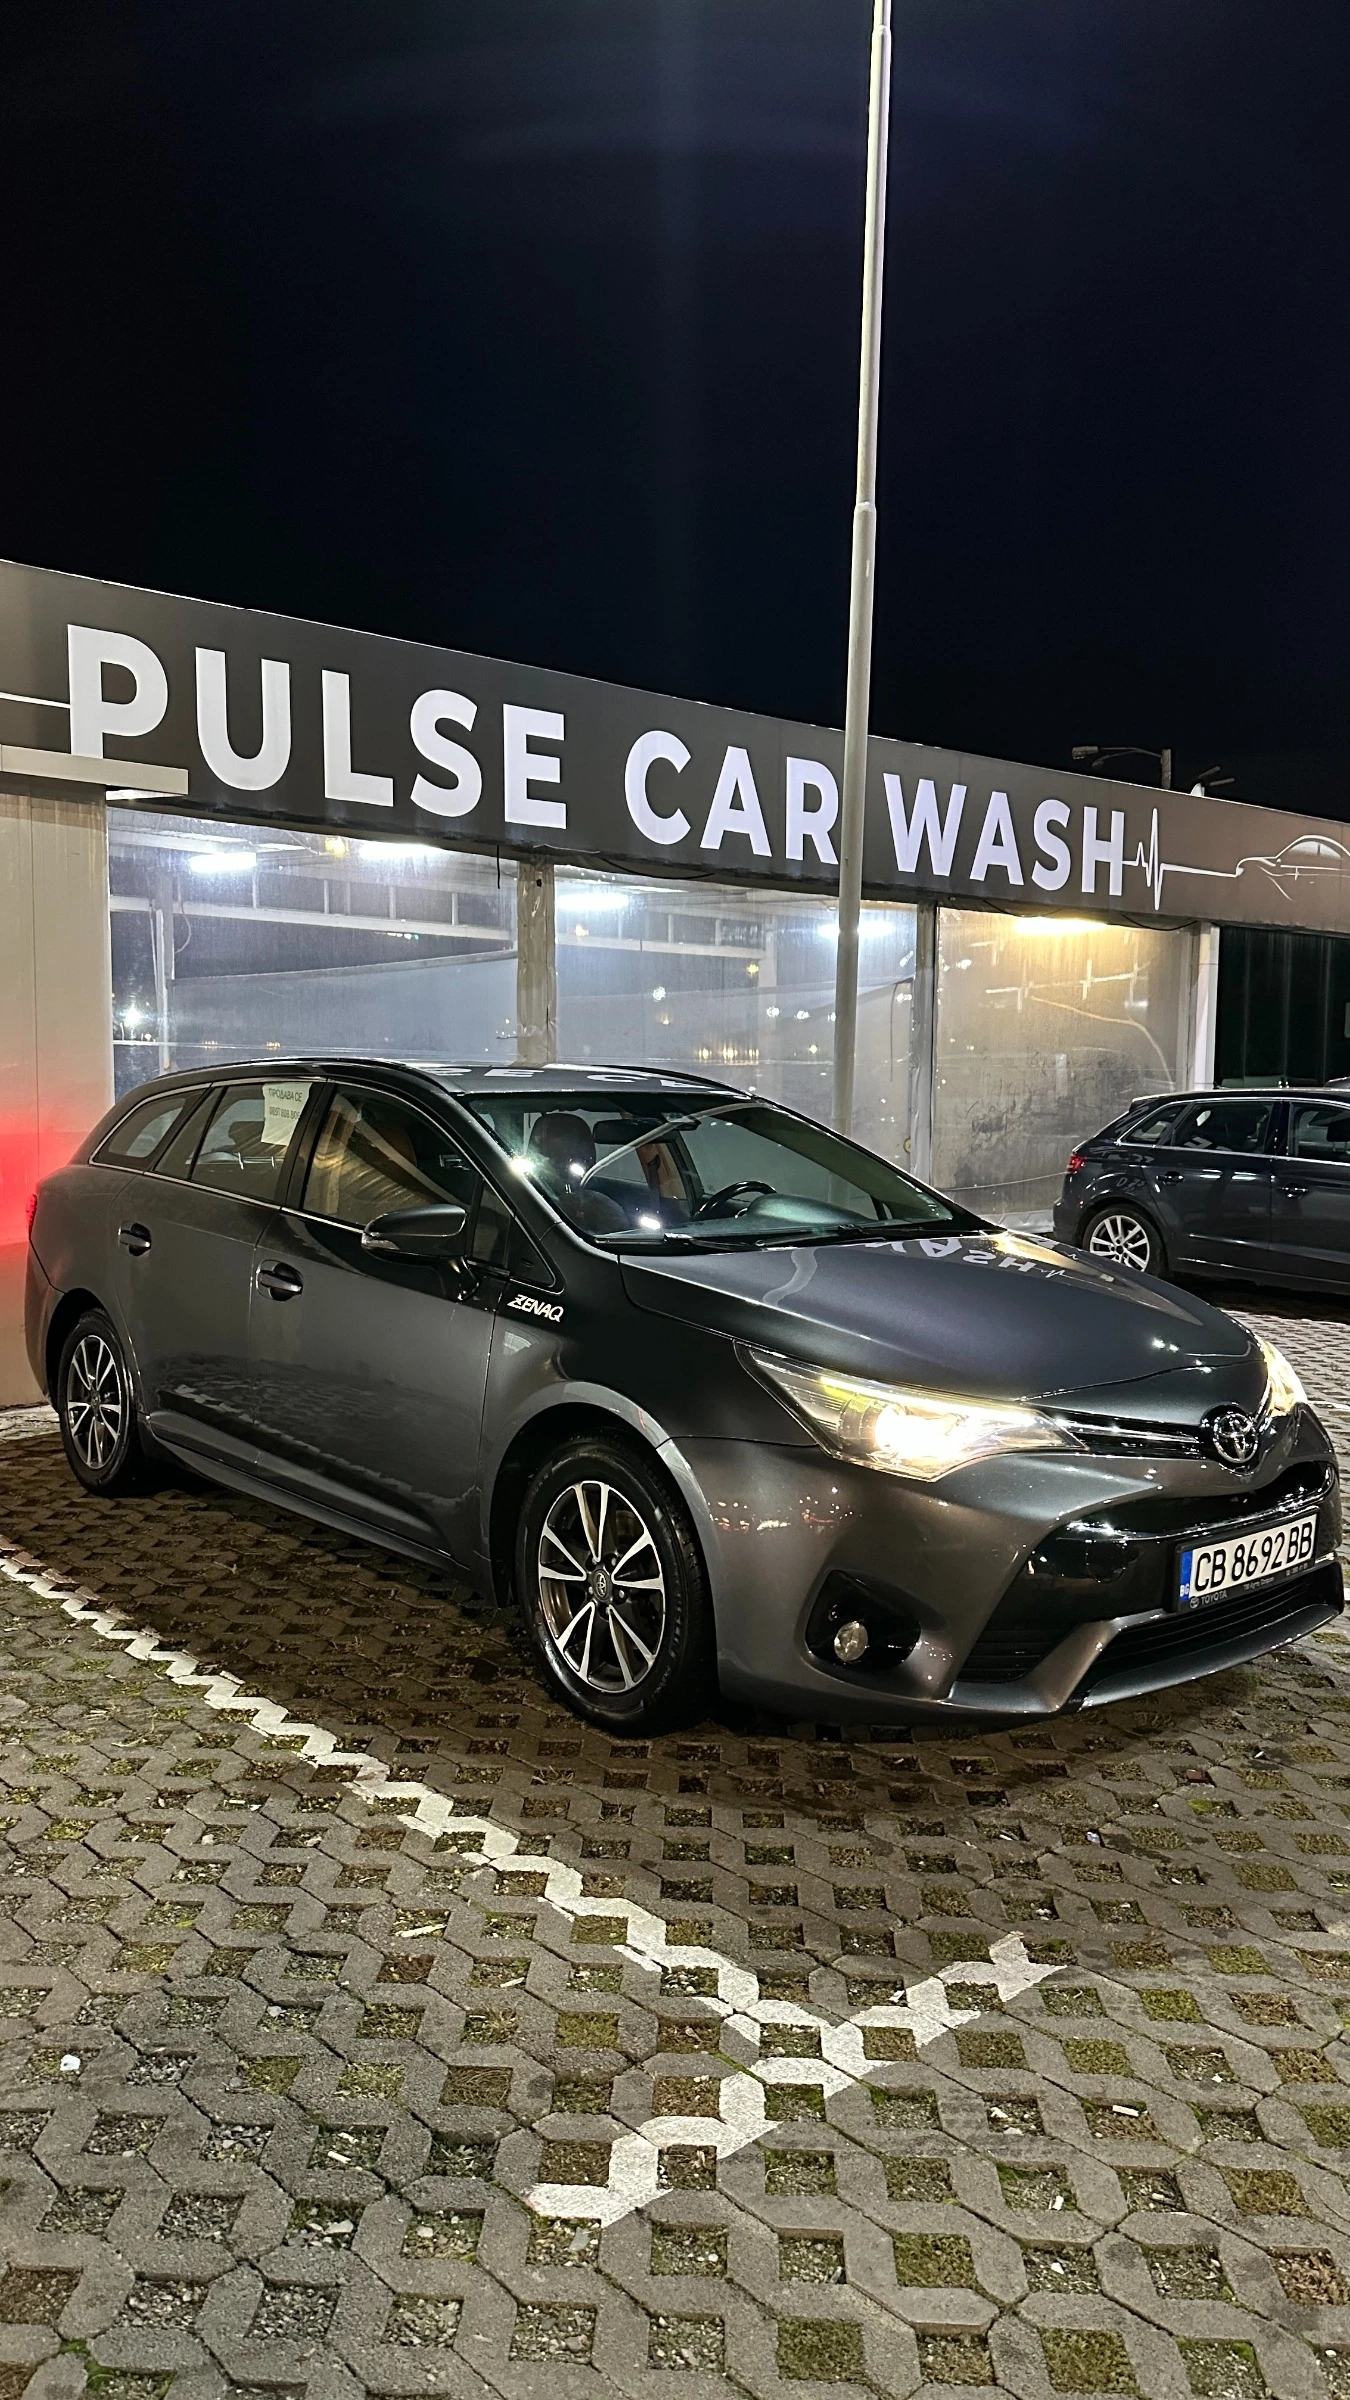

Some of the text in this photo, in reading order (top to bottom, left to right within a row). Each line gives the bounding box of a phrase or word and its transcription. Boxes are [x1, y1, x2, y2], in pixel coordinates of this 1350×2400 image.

[67, 624, 1126, 897] PULSE CAR WASH
[507, 1294, 564, 1322] ZENAQ
[1195, 1521, 1313, 1592] CB 8692 BB
[1180, 1583, 1190, 1597] BG
[1201, 1590, 1227, 1605] TOYOTA
